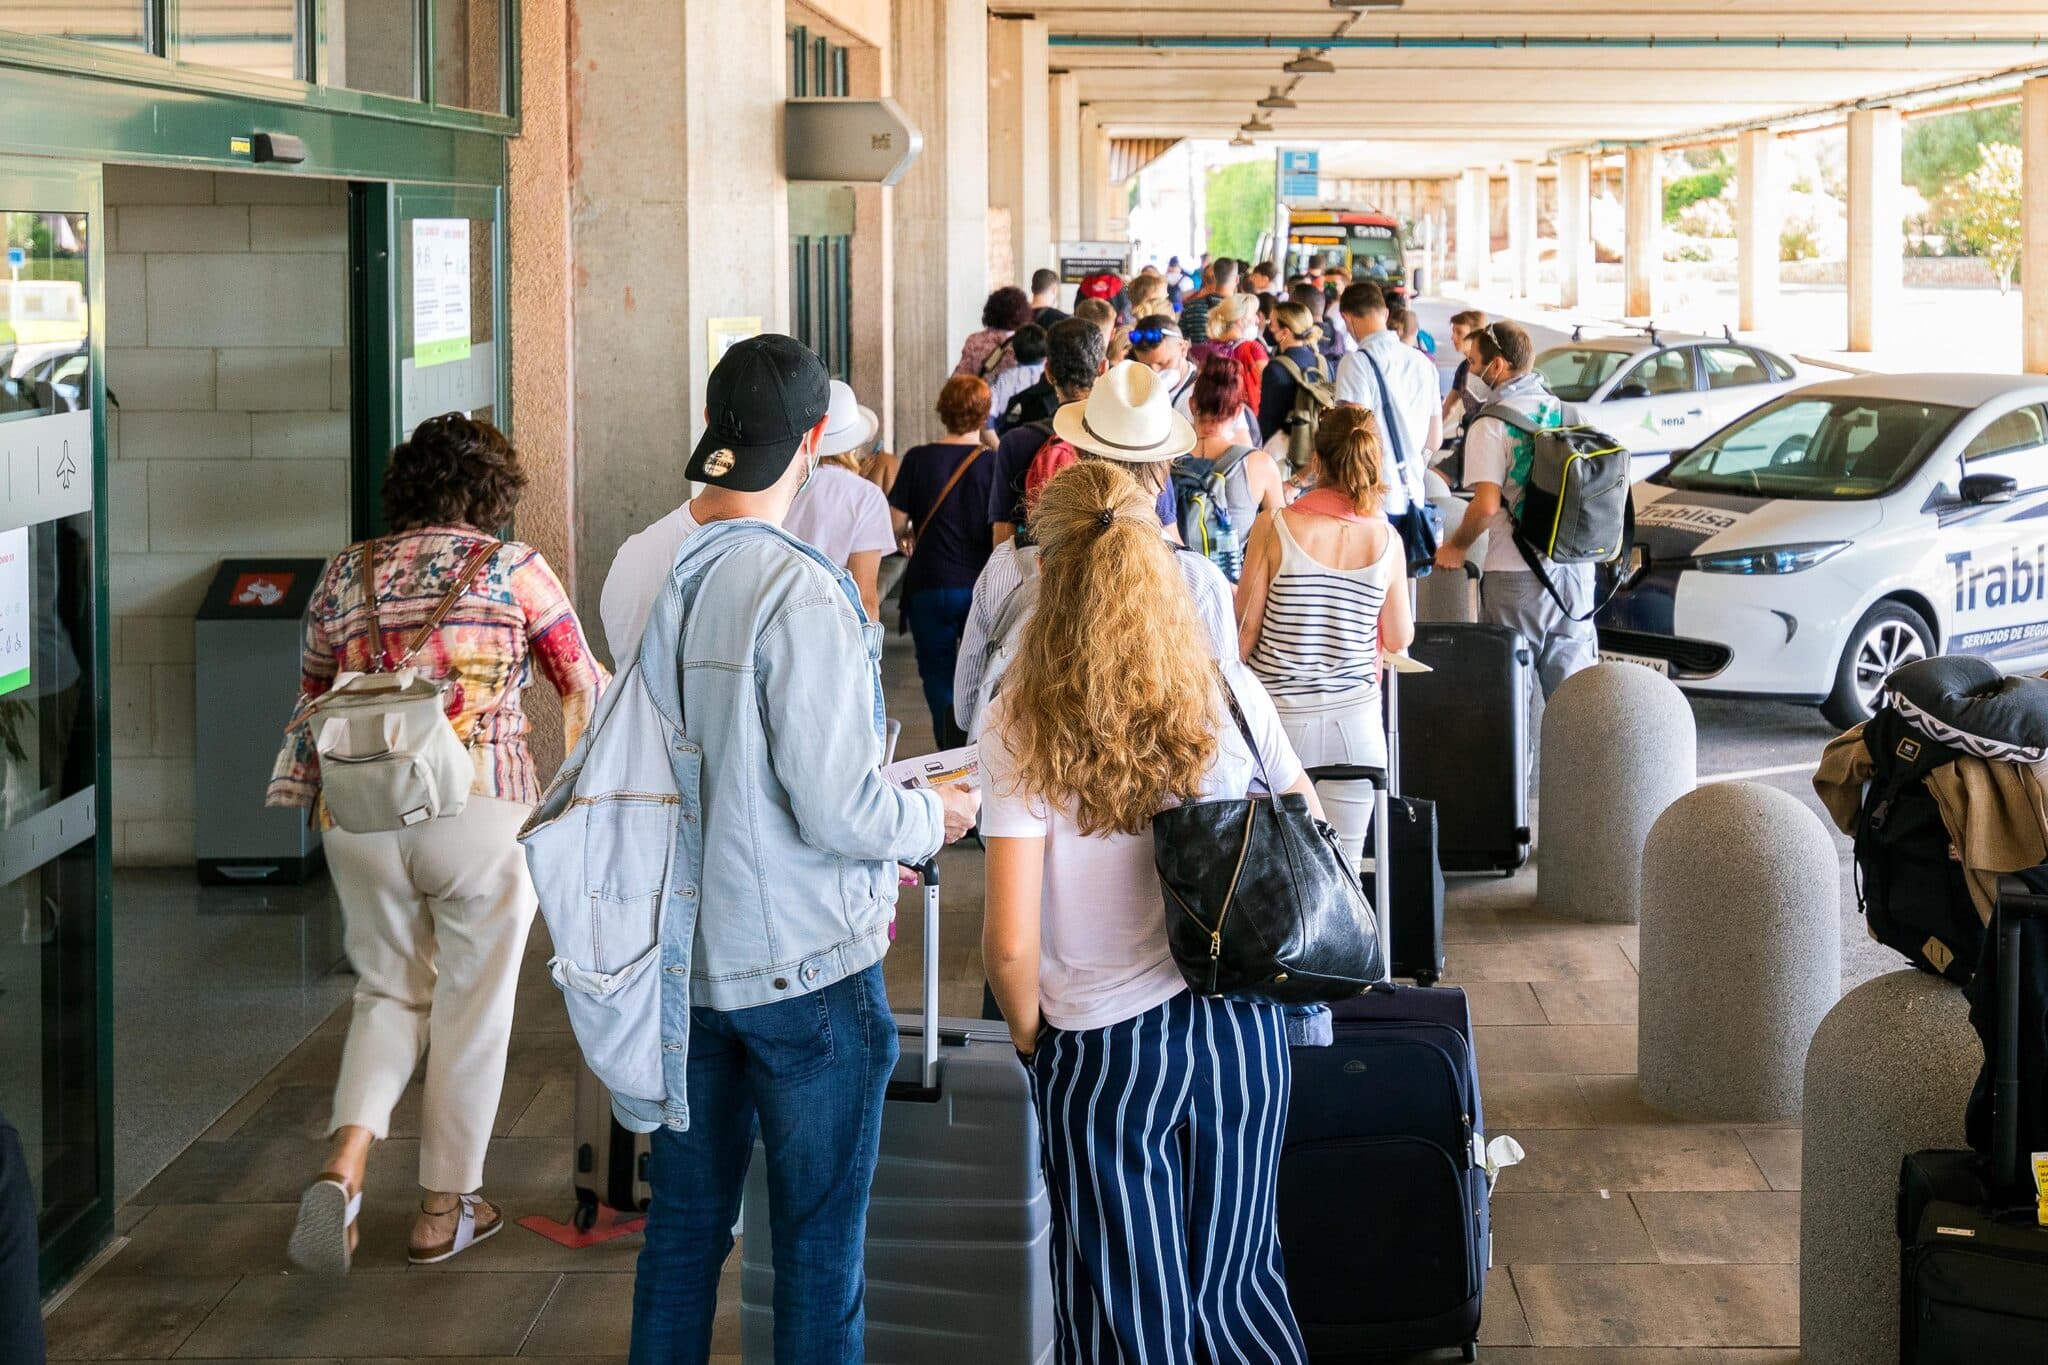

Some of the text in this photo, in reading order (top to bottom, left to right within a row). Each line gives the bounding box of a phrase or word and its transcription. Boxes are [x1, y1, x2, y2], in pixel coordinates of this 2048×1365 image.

[1636, 505, 1737, 528] Trablisa
[1962, 628, 2010, 649] SERVICIOS
[2009, 626, 2024, 641] DE
